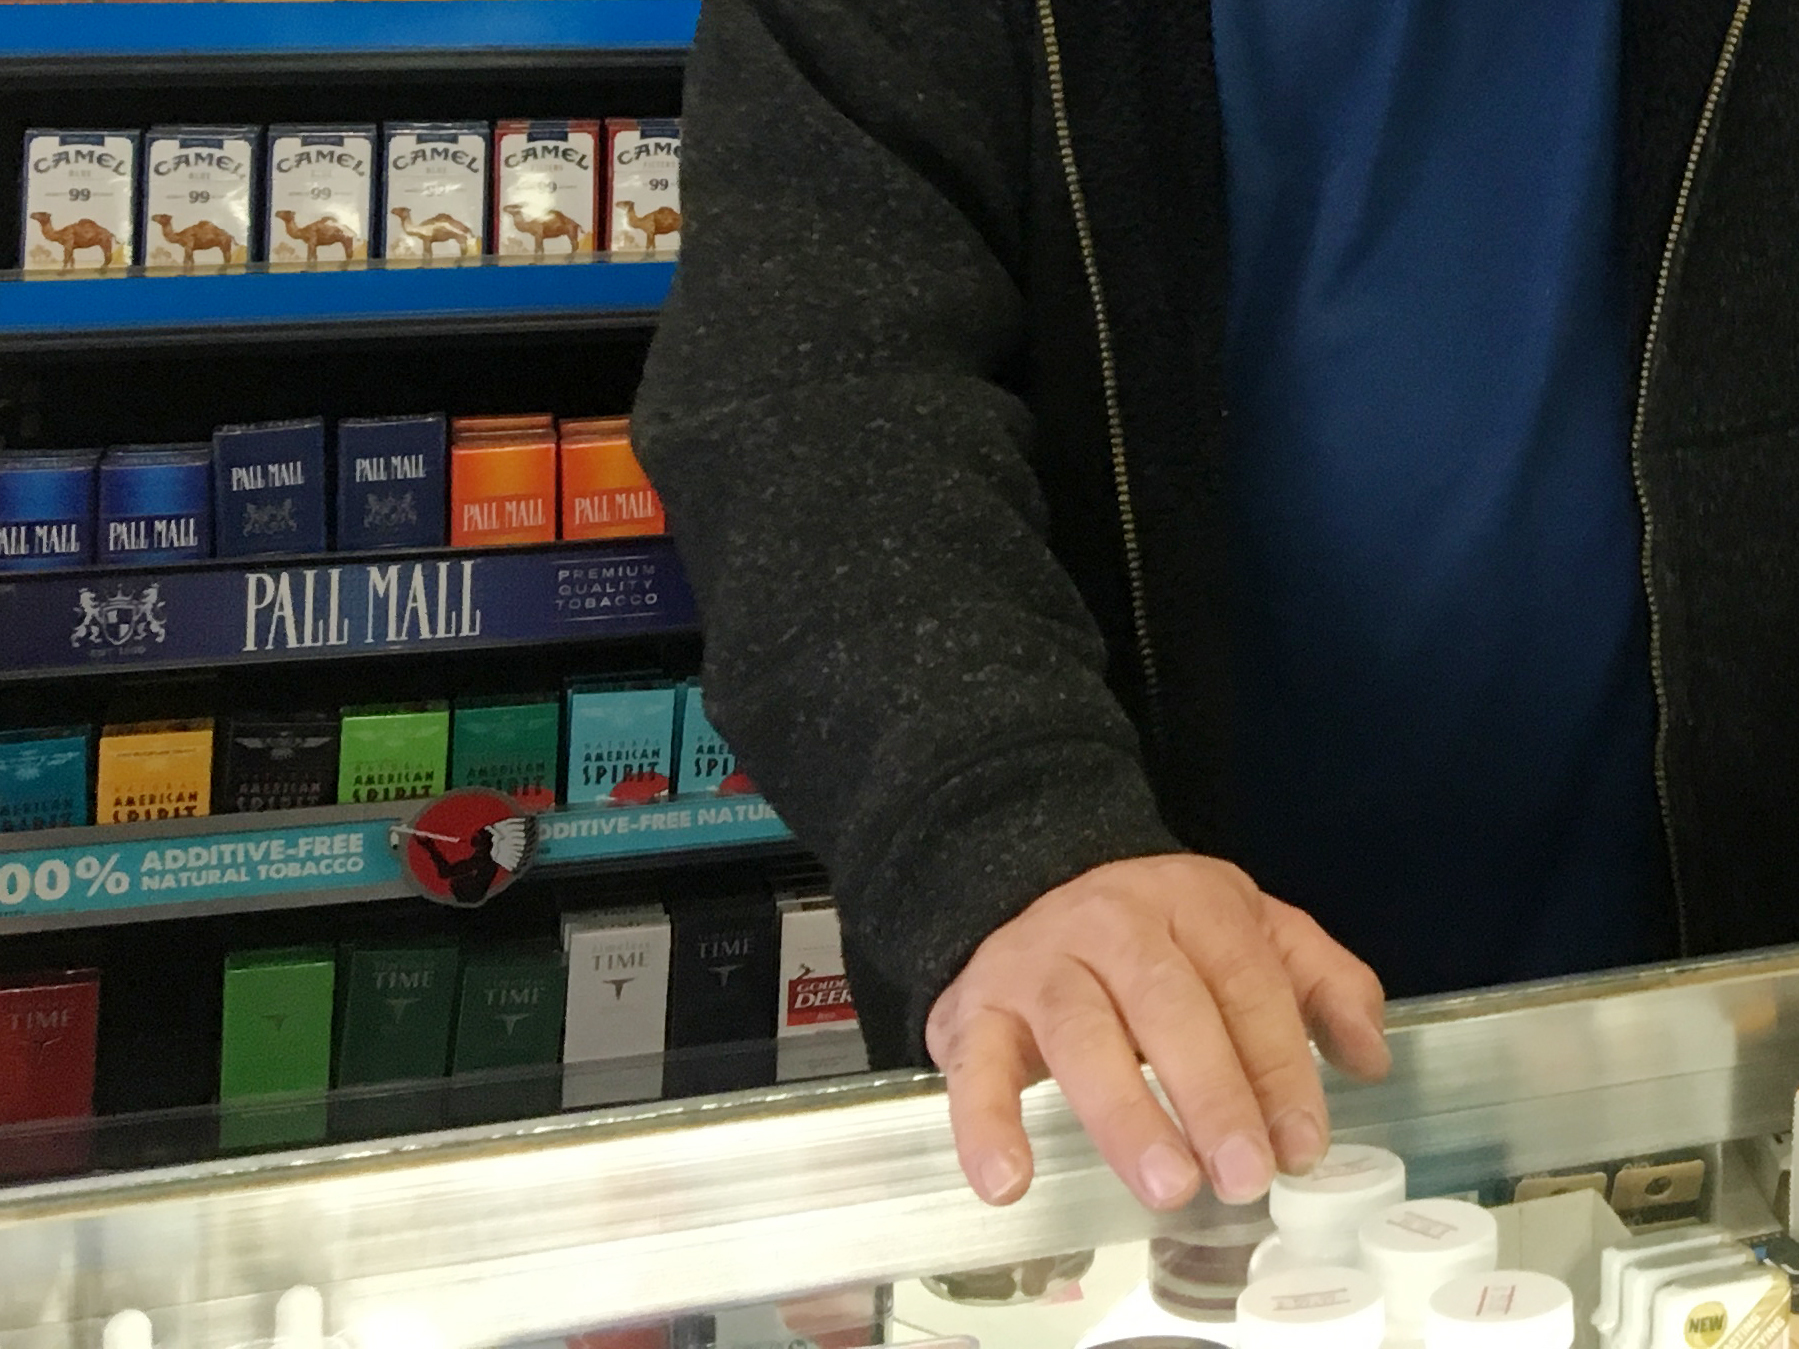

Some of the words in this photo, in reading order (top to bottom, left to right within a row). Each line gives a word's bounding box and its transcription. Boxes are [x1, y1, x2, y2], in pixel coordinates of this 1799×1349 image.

[231, 465, 265, 492] PALL
[267, 461, 304, 488] MALL
[557, 564, 657, 582] PREMIUM
[557, 579, 654, 597] QUALITY
[242, 570, 349, 652] PALL
[364, 559, 482, 643] MALL
[555, 593, 658, 611] TOBACCO
[584, 748, 660, 763] AMERICAN
[583, 762, 660, 786] SPIRIT
[141, 833, 365, 873] ADDITIVE-FREE
[141, 864, 250, 891] NATURAL
[257, 856, 365, 881] TOBACCO
